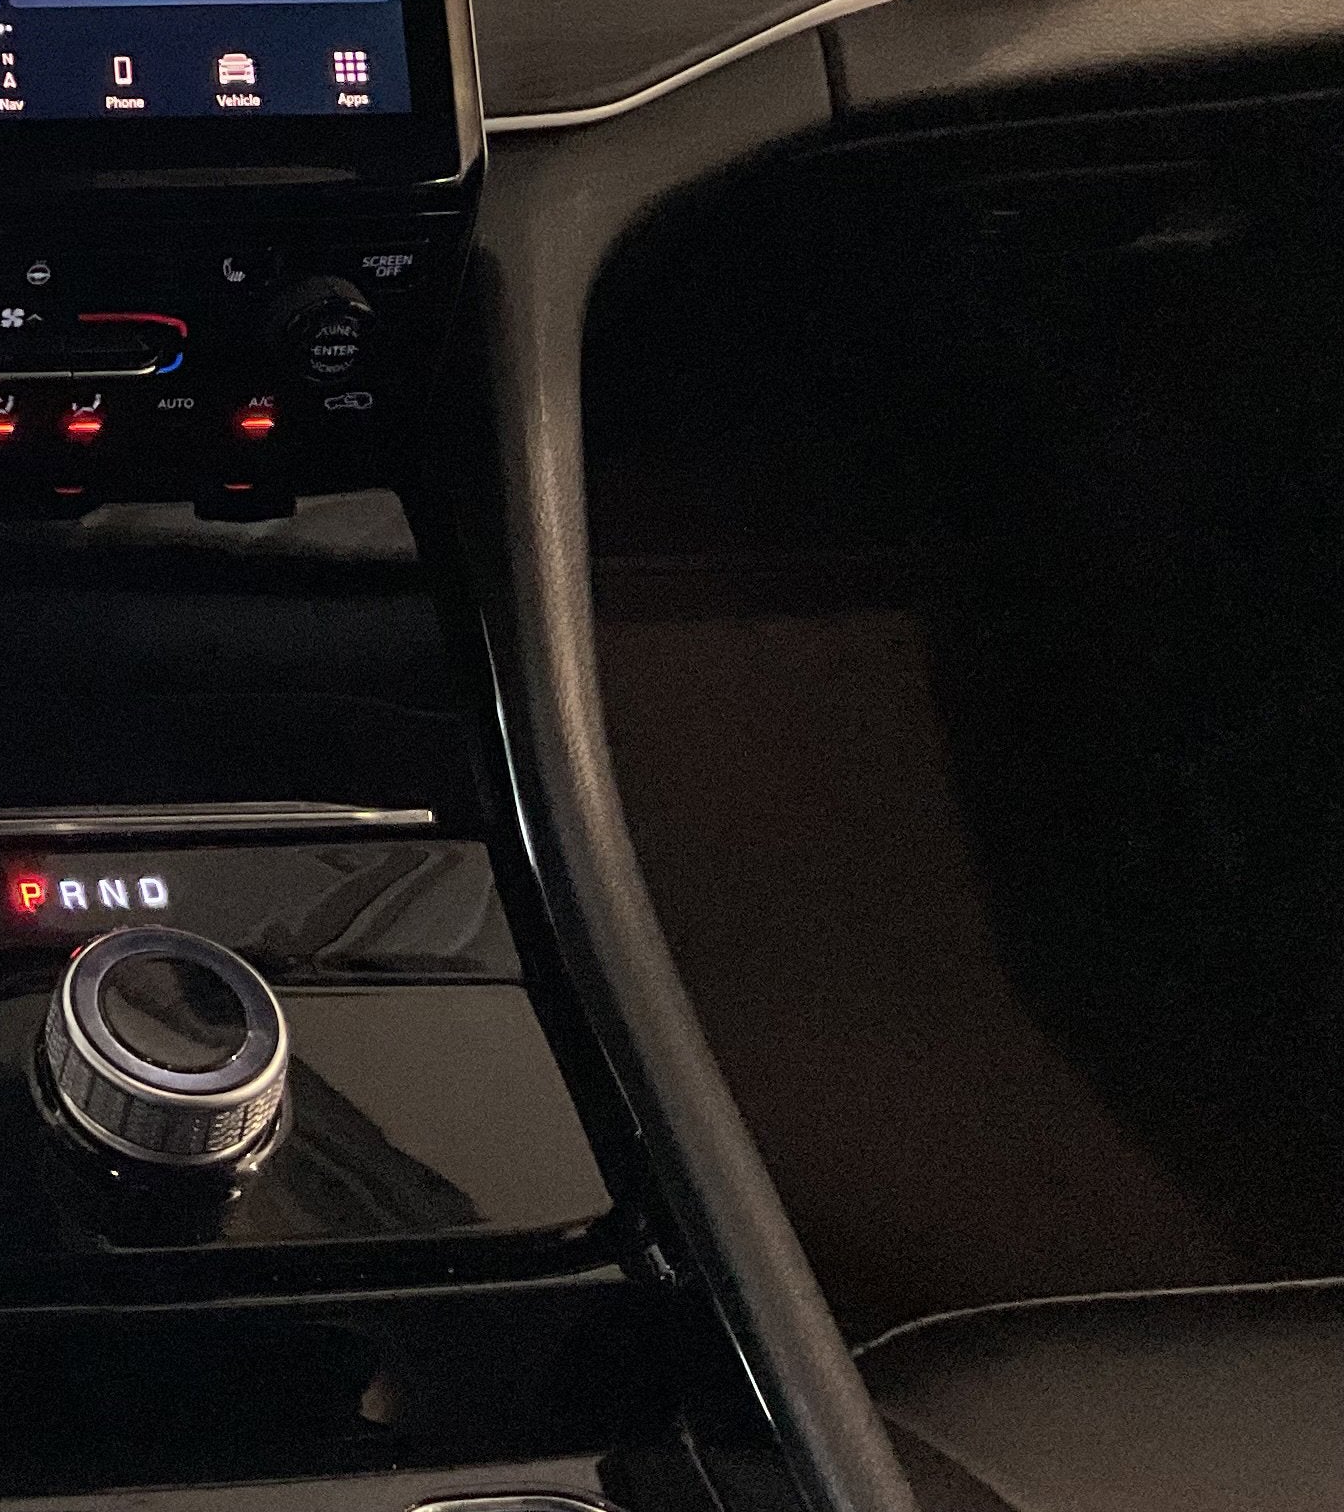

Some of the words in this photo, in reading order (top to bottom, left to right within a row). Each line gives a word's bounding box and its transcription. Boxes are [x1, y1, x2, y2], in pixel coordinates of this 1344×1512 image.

[0, 98, 24, 111] Nav
[106, 95, 145, 109] Phone
[216, 93, 261, 107] Vehicle
[337, 92, 369, 107] Apps
[362, 254, 413, 268] SCREEN
[376, 266, 401, 277] OFF
[313, 345, 355, 356] ENTER
[158, 397, 194, 409] AUTO
[248, 396, 274, 408] A/C
[60, 879, 88, 910] R
[98, 878, 130, 910] N
[139, 877, 169, 908] D
